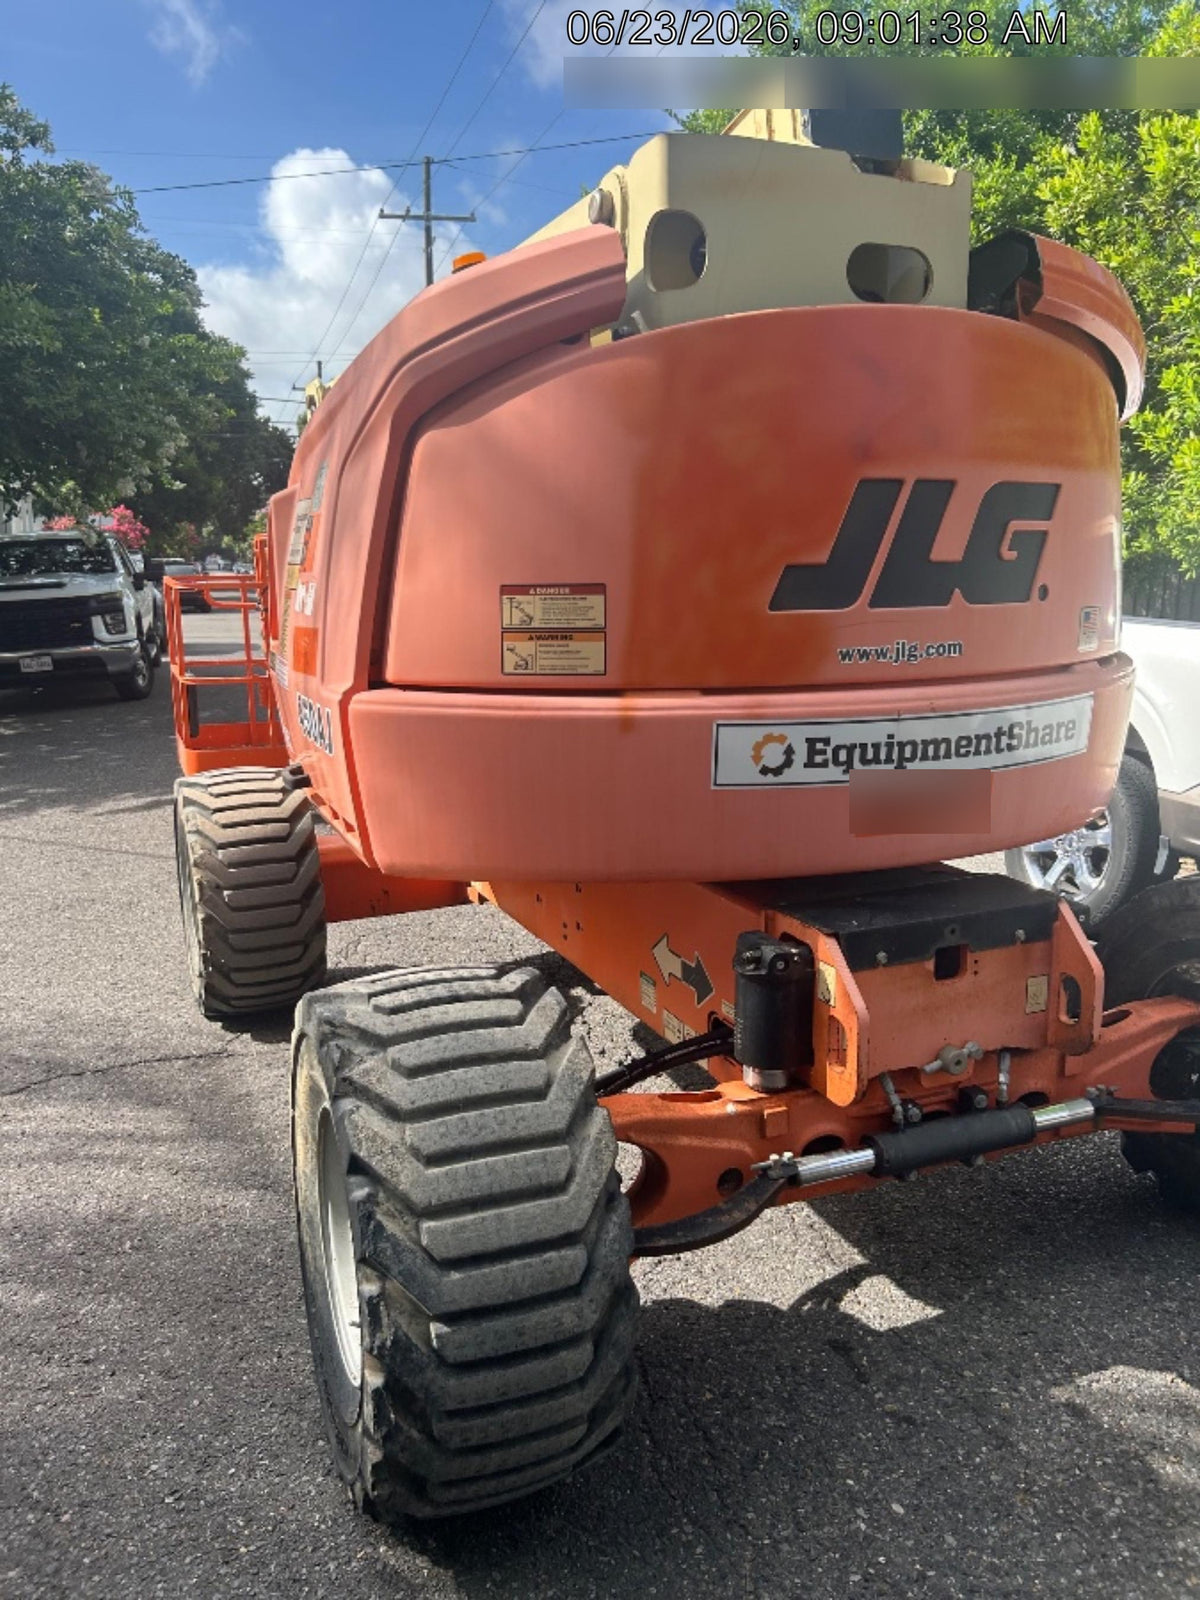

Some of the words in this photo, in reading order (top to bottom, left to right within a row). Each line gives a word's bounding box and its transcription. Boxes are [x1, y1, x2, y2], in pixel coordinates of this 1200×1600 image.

[768, 478, 1061, 612] JLG
[838, 639, 963, 664] www.jlg.com
[803, 718, 1076, 774] EquipmentShare
